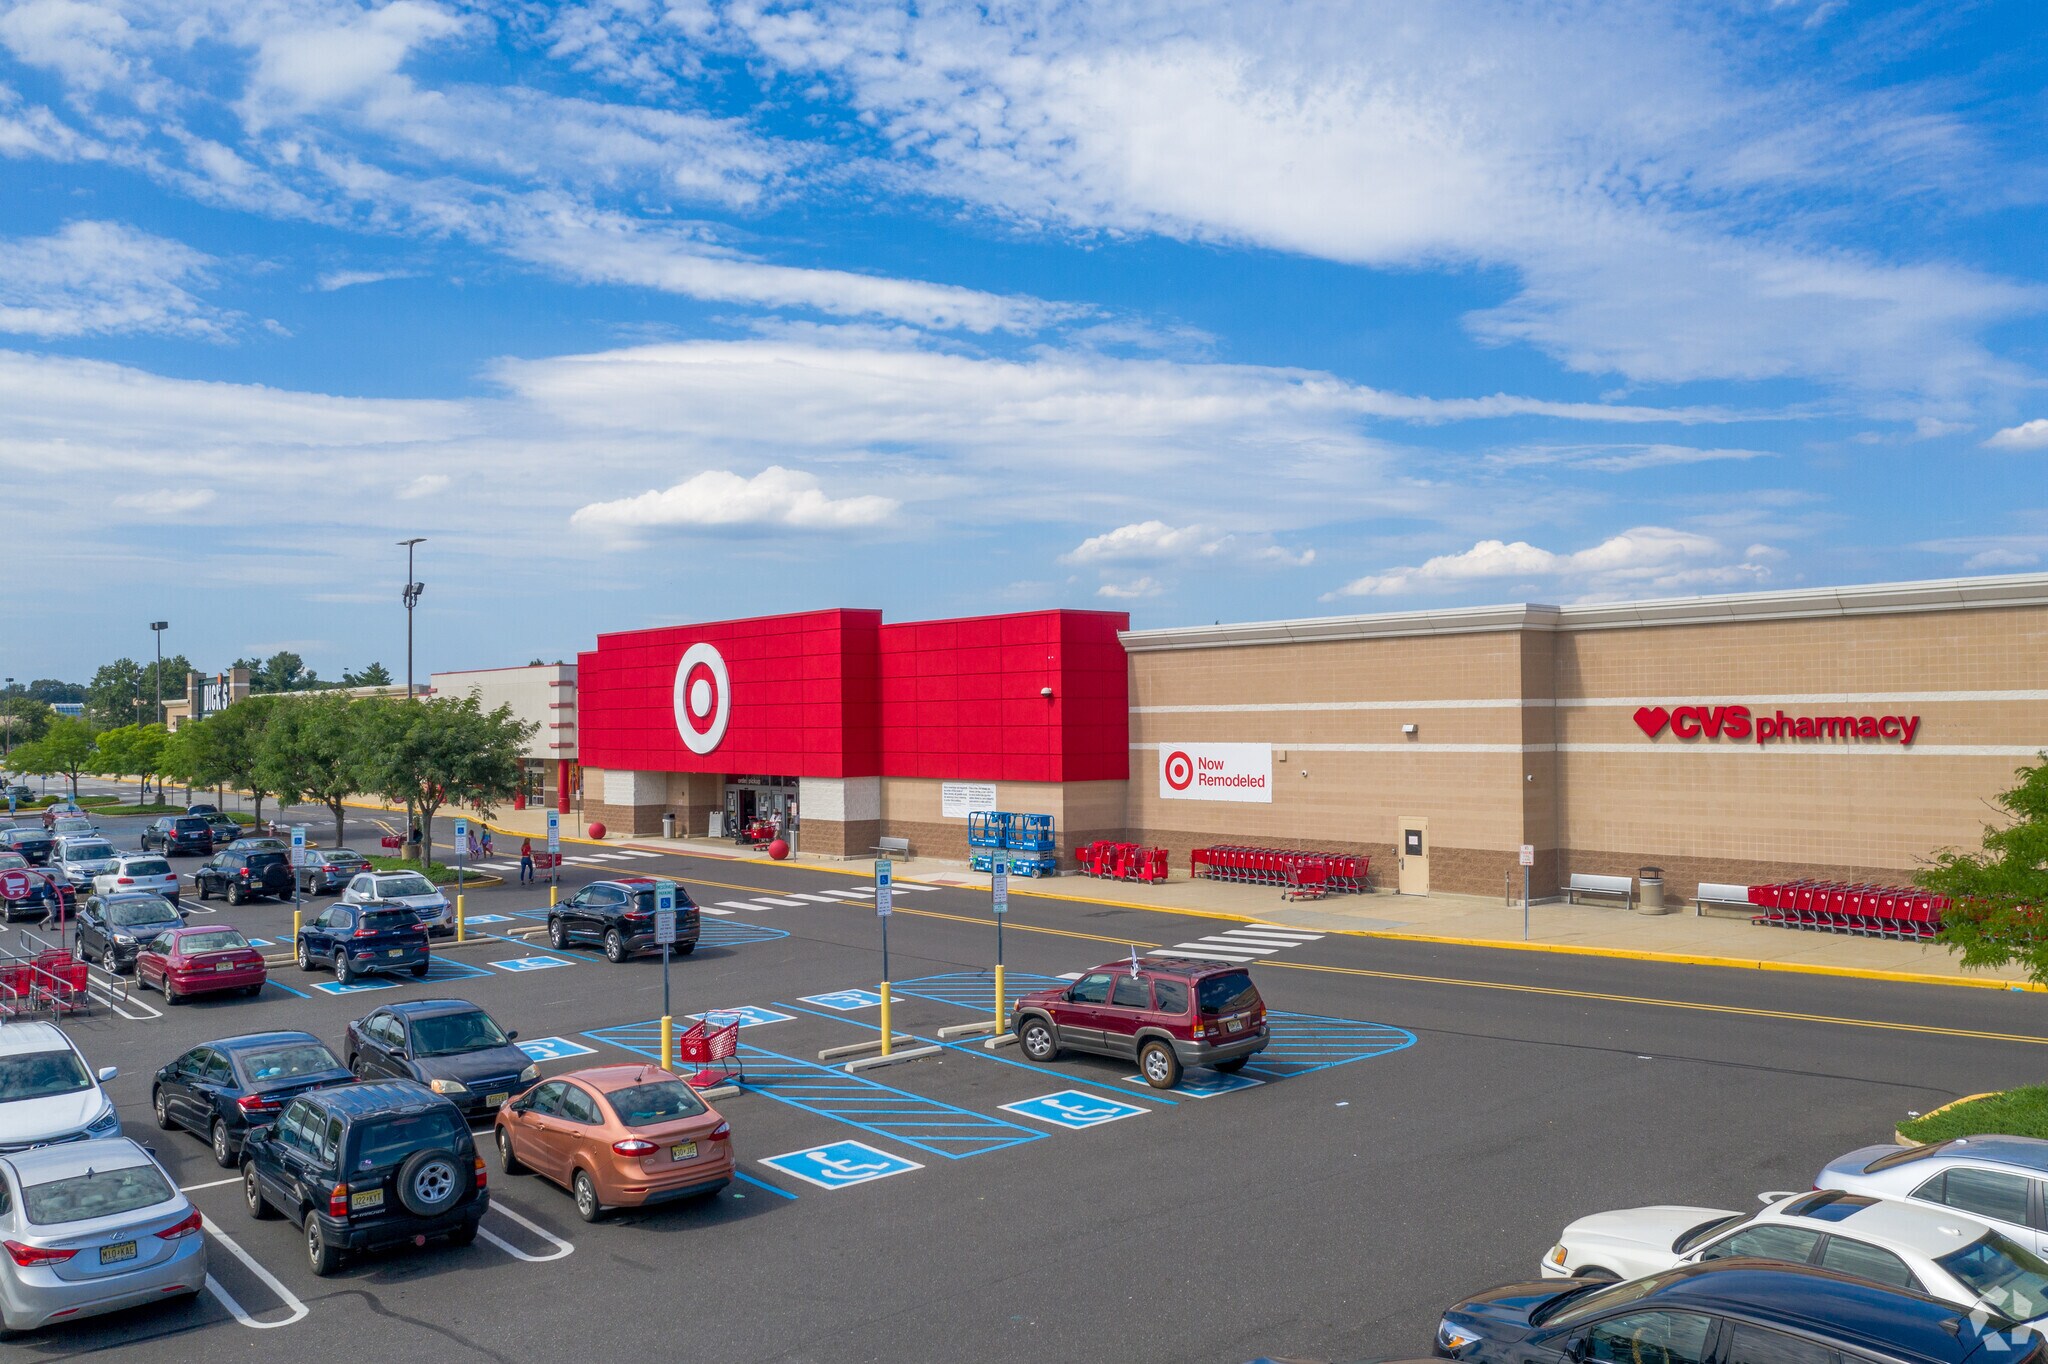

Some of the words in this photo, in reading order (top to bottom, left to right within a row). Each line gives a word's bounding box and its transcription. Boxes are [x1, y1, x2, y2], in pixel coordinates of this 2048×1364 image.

[204, 672, 228, 711] DICK'S
[1670, 705, 1752, 739] CVS
[1756, 710, 1919, 744] pharmacy
[1198, 756, 1224, 770] Now
[1198, 772, 1266, 788] Remodeled
